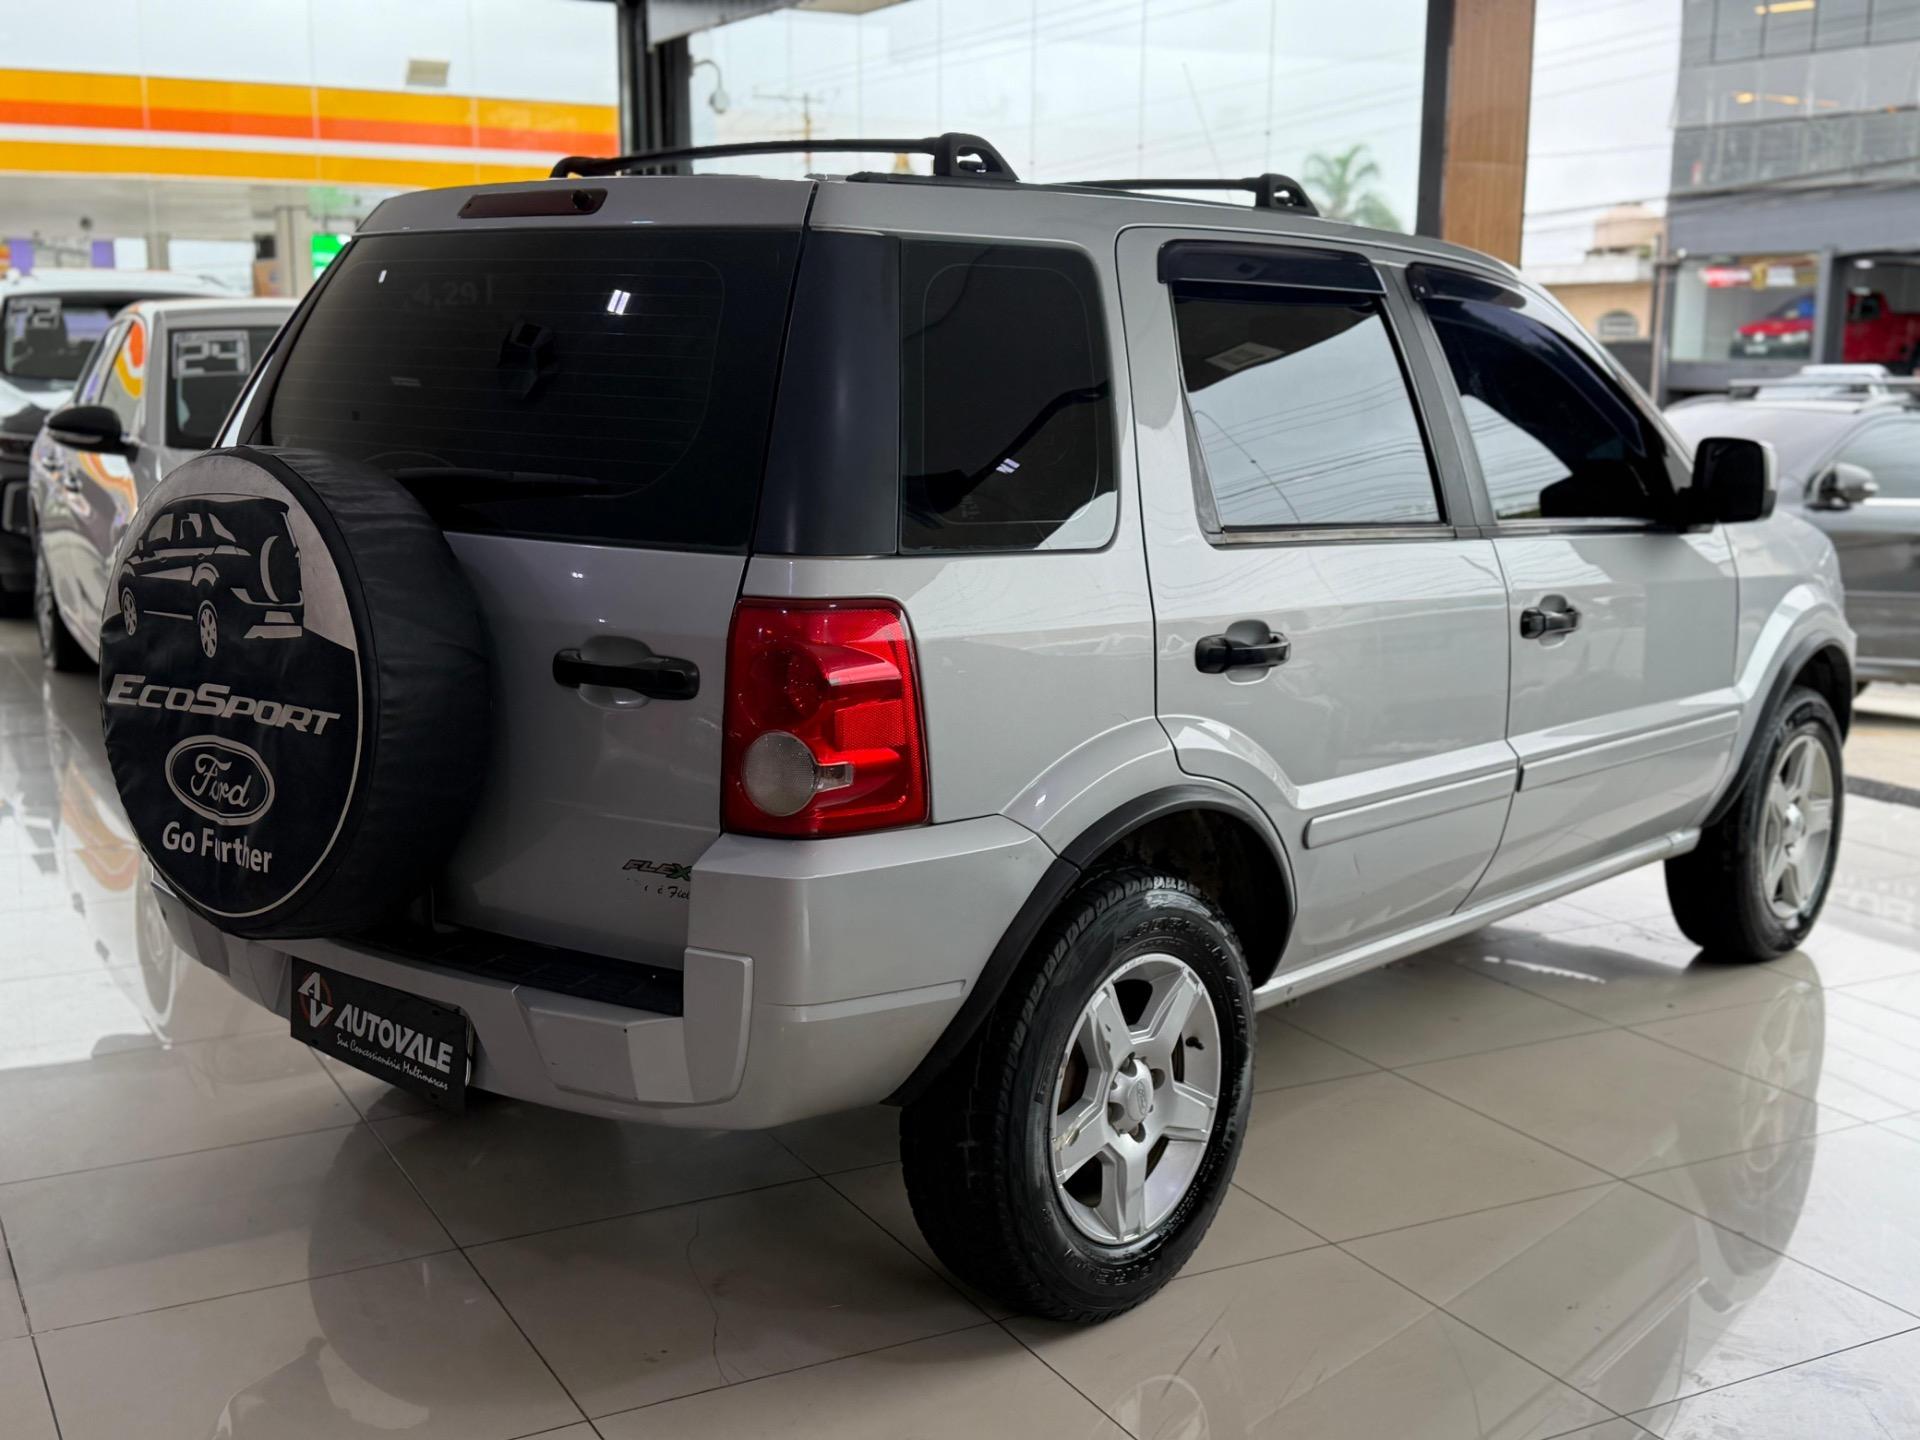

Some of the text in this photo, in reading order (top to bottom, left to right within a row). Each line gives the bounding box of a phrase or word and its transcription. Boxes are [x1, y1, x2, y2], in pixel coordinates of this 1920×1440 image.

[190, 753, 252, 807] Ford
[162, 821, 273, 873] Go Further
[622, 859, 692, 881] FLEX
[334, 1003, 453, 1074] AUTOVALE
